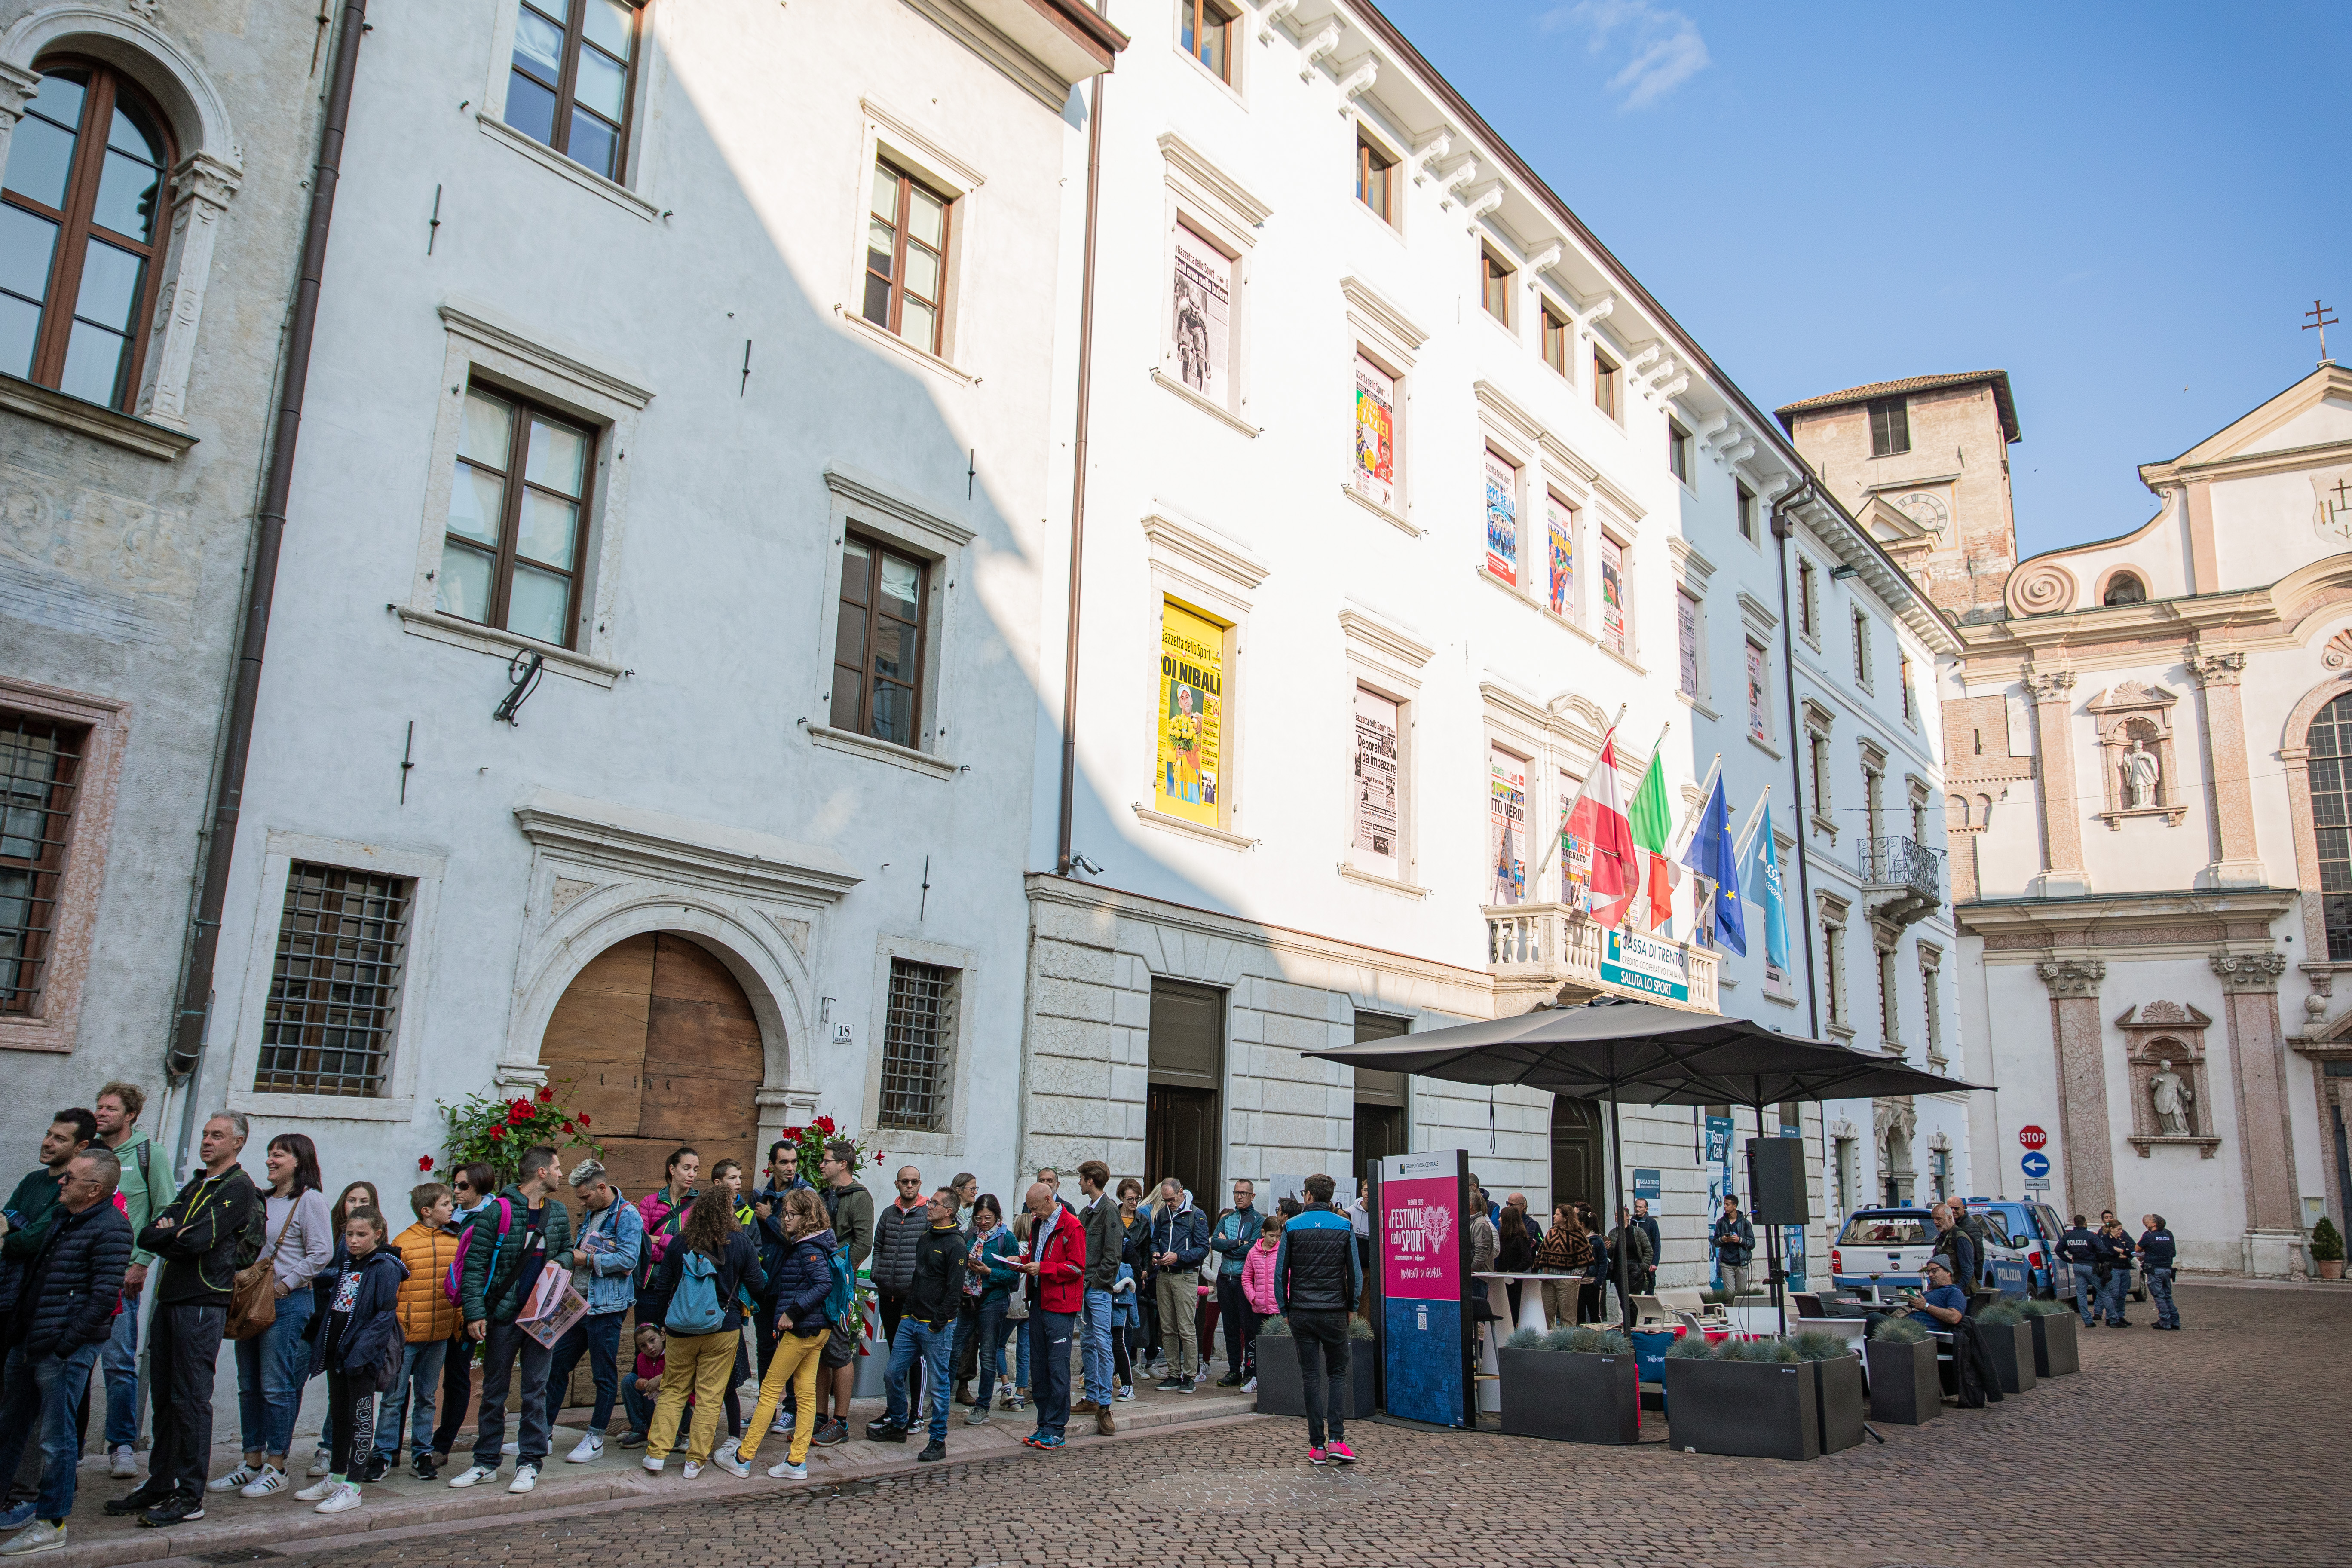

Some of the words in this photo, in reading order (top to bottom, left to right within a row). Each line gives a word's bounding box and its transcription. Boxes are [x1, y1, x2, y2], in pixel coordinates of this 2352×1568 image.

[1178, 245, 1194, 265] Gazzetta
[1195, 257, 1204, 270] dello
[1204, 263, 1215, 279] Sport
[1187, 267, 1199, 283] eroe
[1199, 276, 1212, 292] nella
[1212, 282, 1228, 303] bufera
[1376, 382, 1385, 398] Sport
[1359, 397, 1381, 420] GRAZIE!
[1500, 493, 1515, 511] BELLO
[1185, 639, 1197, 655] dello
[1197, 643, 1211, 662] Sport
[1161, 655, 1176, 679] OI
[1179, 661, 1221, 696] NIBALÌ
[1377, 721, 1387, 733] Sport
[1358, 734, 1382, 755] Deborah
[1362, 750, 1369, 764] da
[1370, 752, 1396, 774] impazzire
[1372, 776, 1384, 786] Tomba!
[1504, 802, 1524, 823] VERO!
[1510, 819, 1525, 833] MONDO
[1562, 847, 1586, 863] TORNATO
[1622, 935, 1647, 956] CASSA
[1649, 943, 1656, 959] DI
[1658, 946, 1684, 968] TRENTO
[1622, 956, 1639, 967] CREDITO
[1639, 961, 1666, 975] COOPERATIVO
[1667, 969, 1684, 980] ITALIANO
[1621, 970, 1644, 988] SALUTA
[1644, 977, 1653, 990] LO
[1654, 980, 1672, 995] SPORT
[839, 1025, 850, 1037] 18
[1712, 1130, 1723, 1144] Gazza
[2021, 1133, 2046, 1143] STOP
[1713, 1145, 1723, 1158] Cafè
[1391, 1208, 1424, 1228] FESTIVAL
[1391, 1231, 1401, 1244] dello
[1401, 1230, 1426, 1252] SPORT
[1420, 1269, 1425, 1278] DI
[1426, 1267, 1442, 1278] GLORIA
[1998, 1268, 2021, 1282] POLIZIA
[353, 1396, 372, 1464] adidas
